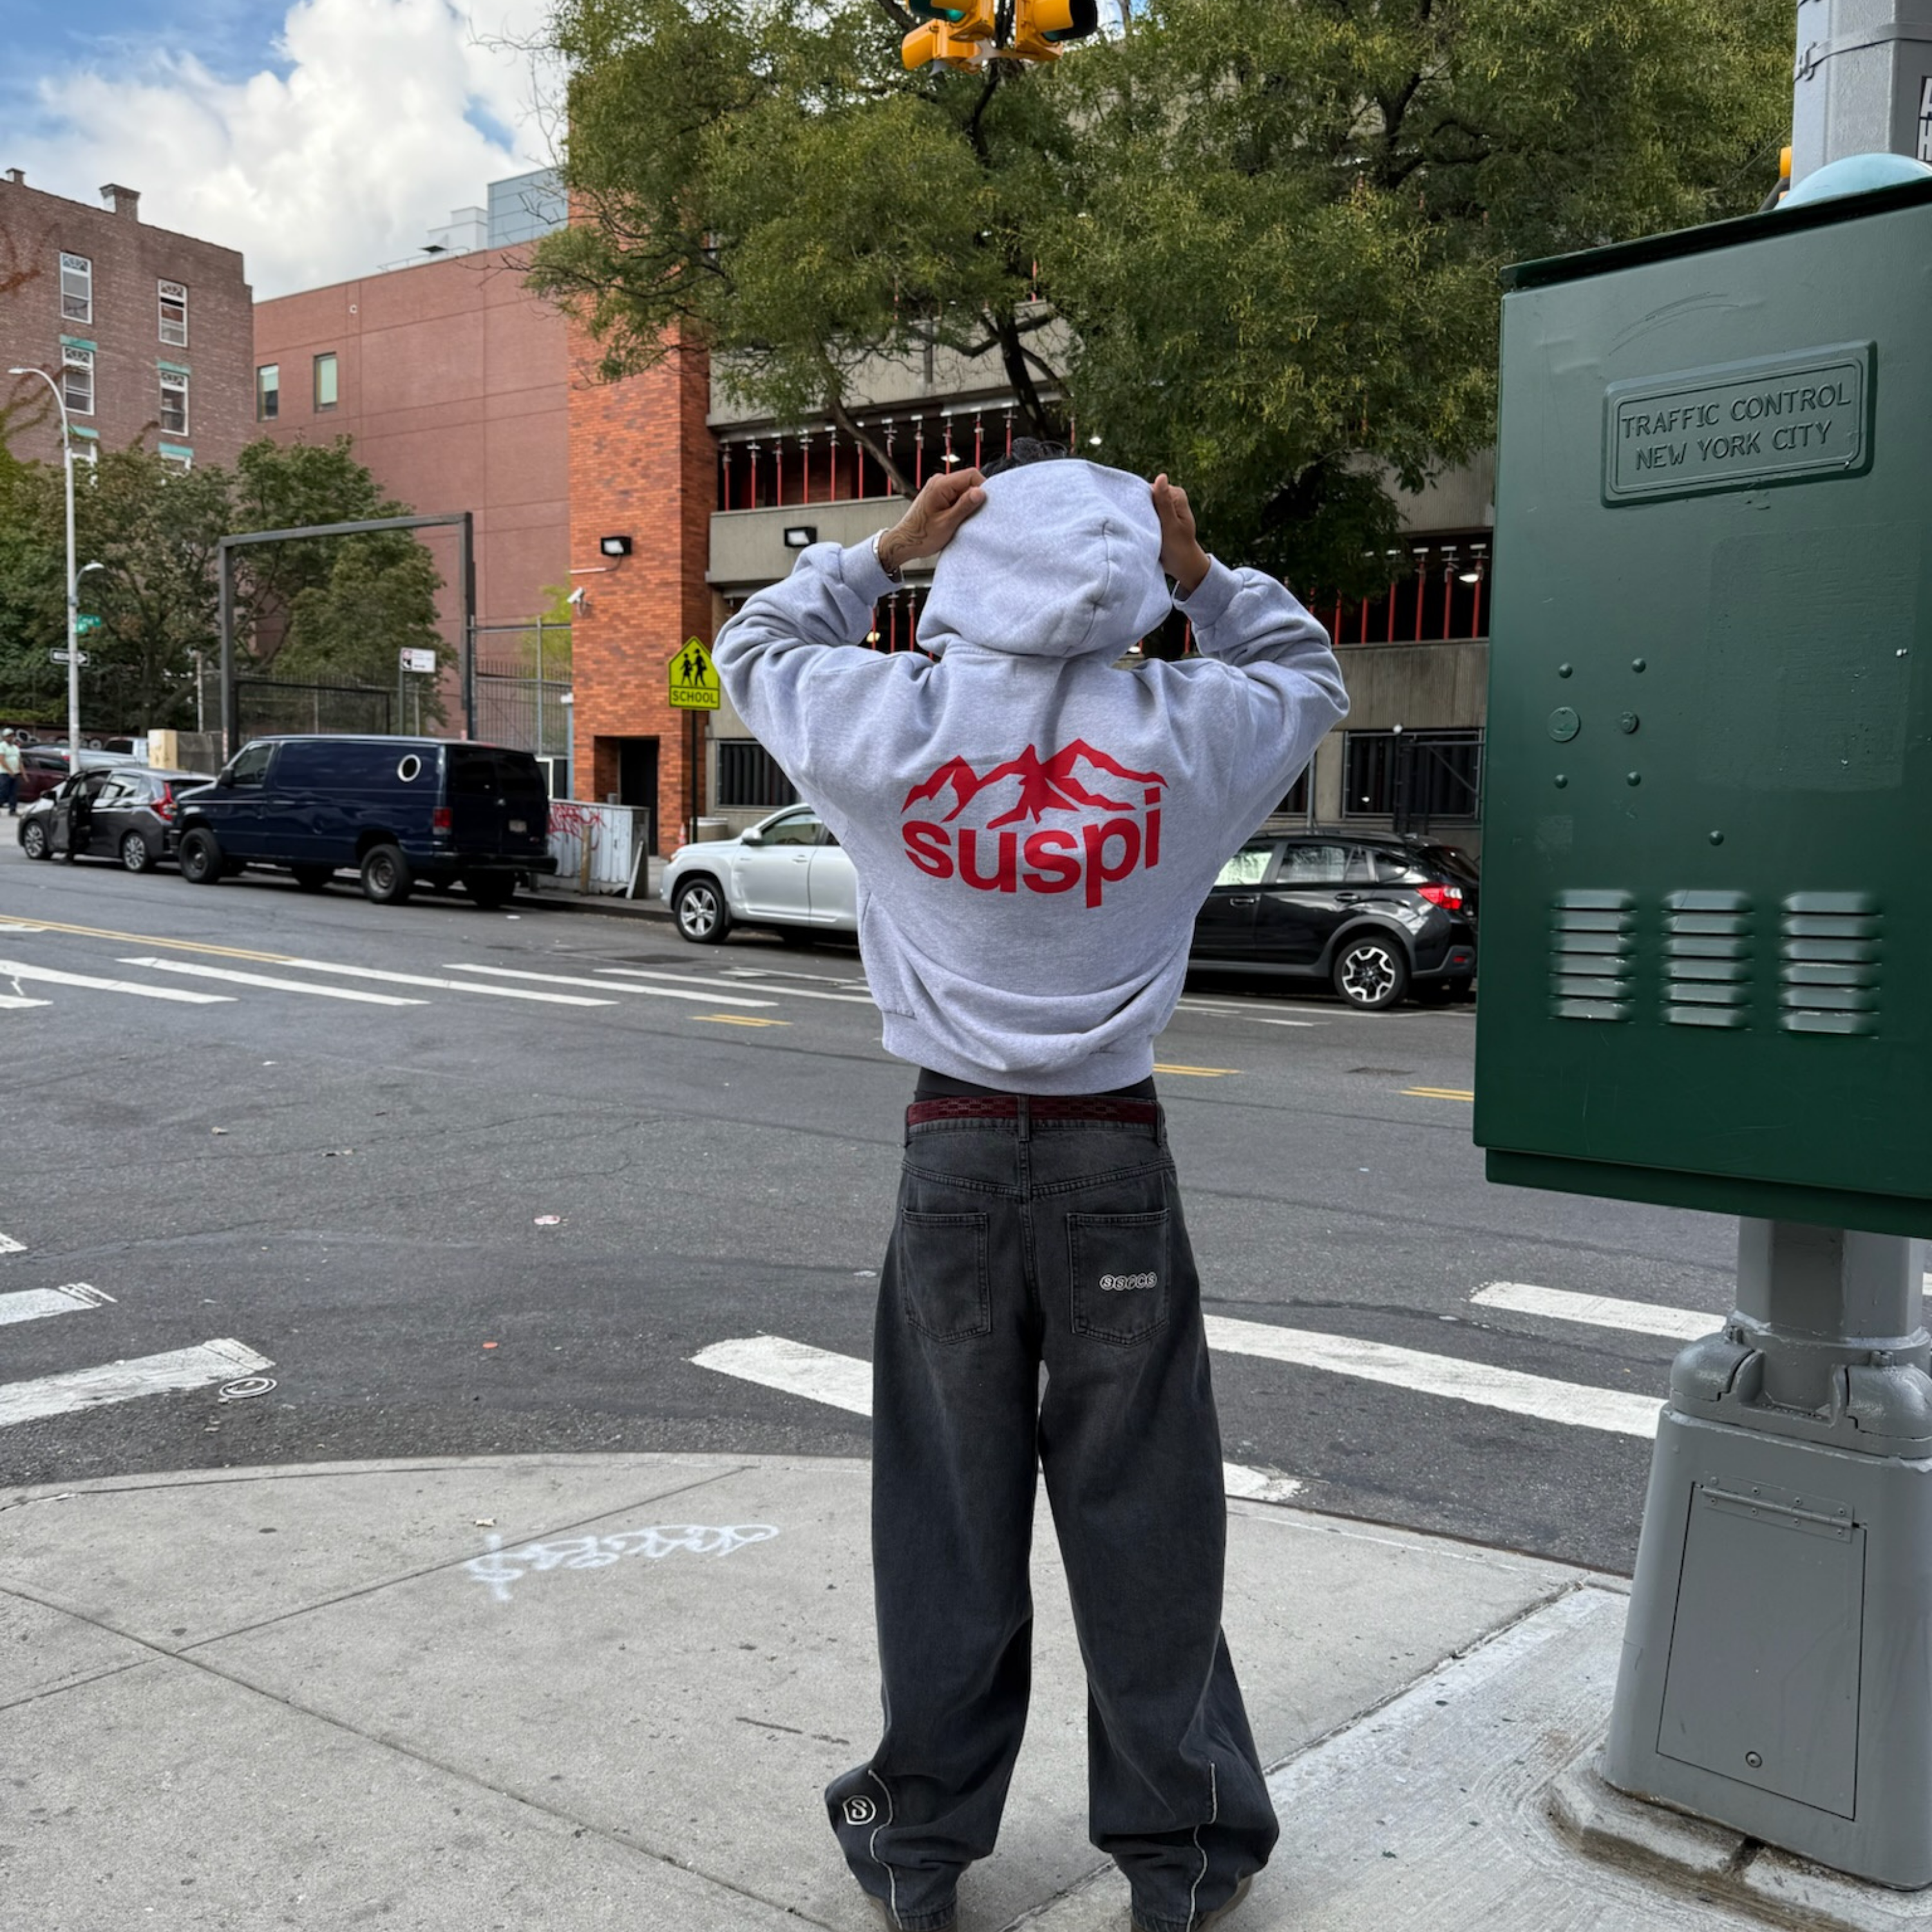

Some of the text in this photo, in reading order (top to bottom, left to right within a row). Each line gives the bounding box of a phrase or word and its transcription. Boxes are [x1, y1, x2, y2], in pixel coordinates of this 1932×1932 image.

[1621, 382, 1852, 439] TRAFFIC CONTROL
[1636, 420, 1832, 471] NEW YORK CITY
[672, 690, 717, 704] SCHOOL
[902, 787, 1161, 909] suspi
